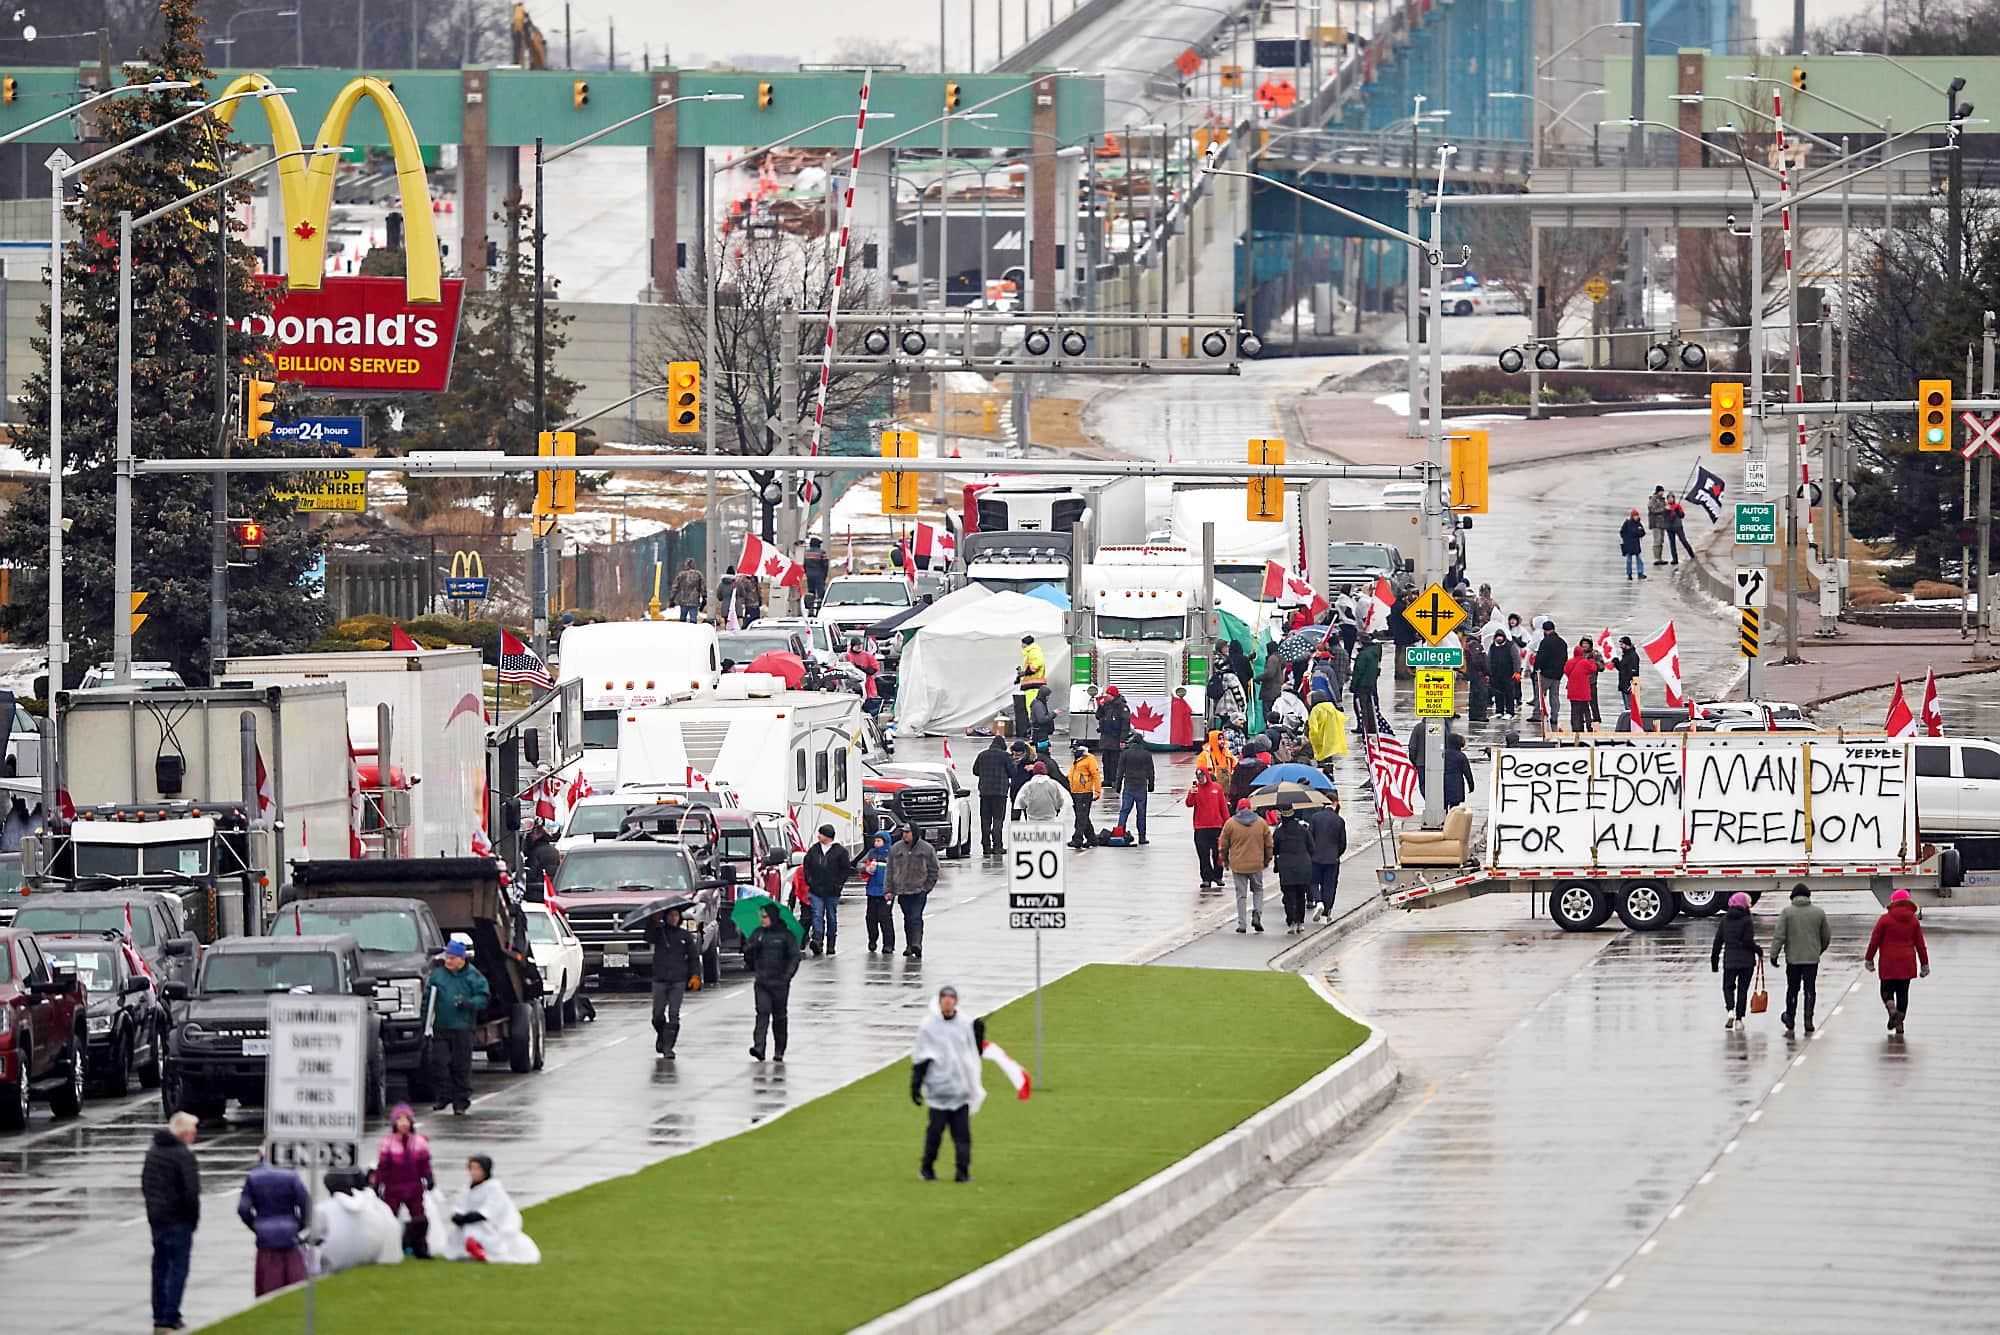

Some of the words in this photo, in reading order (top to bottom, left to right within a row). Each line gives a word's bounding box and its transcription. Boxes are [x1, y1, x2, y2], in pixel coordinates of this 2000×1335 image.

[278, 356, 345, 372] BILLION
[350, 357, 420, 374] SERVED
[275, 427, 299, 436] open
[299, 422, 323, 440] 24
[324, 427, 349, 435] hours
[327, 483, 365, 495] HERE!
[1408, 650, 1451, 664] College
[1846, 747, 1903, 759] YEEYEE
[1501, 755, 1589, 779] Peace
[1600, 752, 1677, 778] LOVE
[1501, 775, 1682, 814] FREEDOM
[1013, 831, 1061, 842] MAXIMUM
[1690, 808, 1882, 849] FREEDOM
[1497, 823, 1564, 852] FOR
[1596, 823, 1677, 852] ALL
[1015, 850, 1058, 880] 50
[1016, 894, 1058, 907] km/h
[1012, 913, 1064, 927] BEGINS
[297, 1058, 334, 1074] ZONE
[296, 1088, 335, 1104] FINES
[274, 1141, 352, 1166] ENDS
